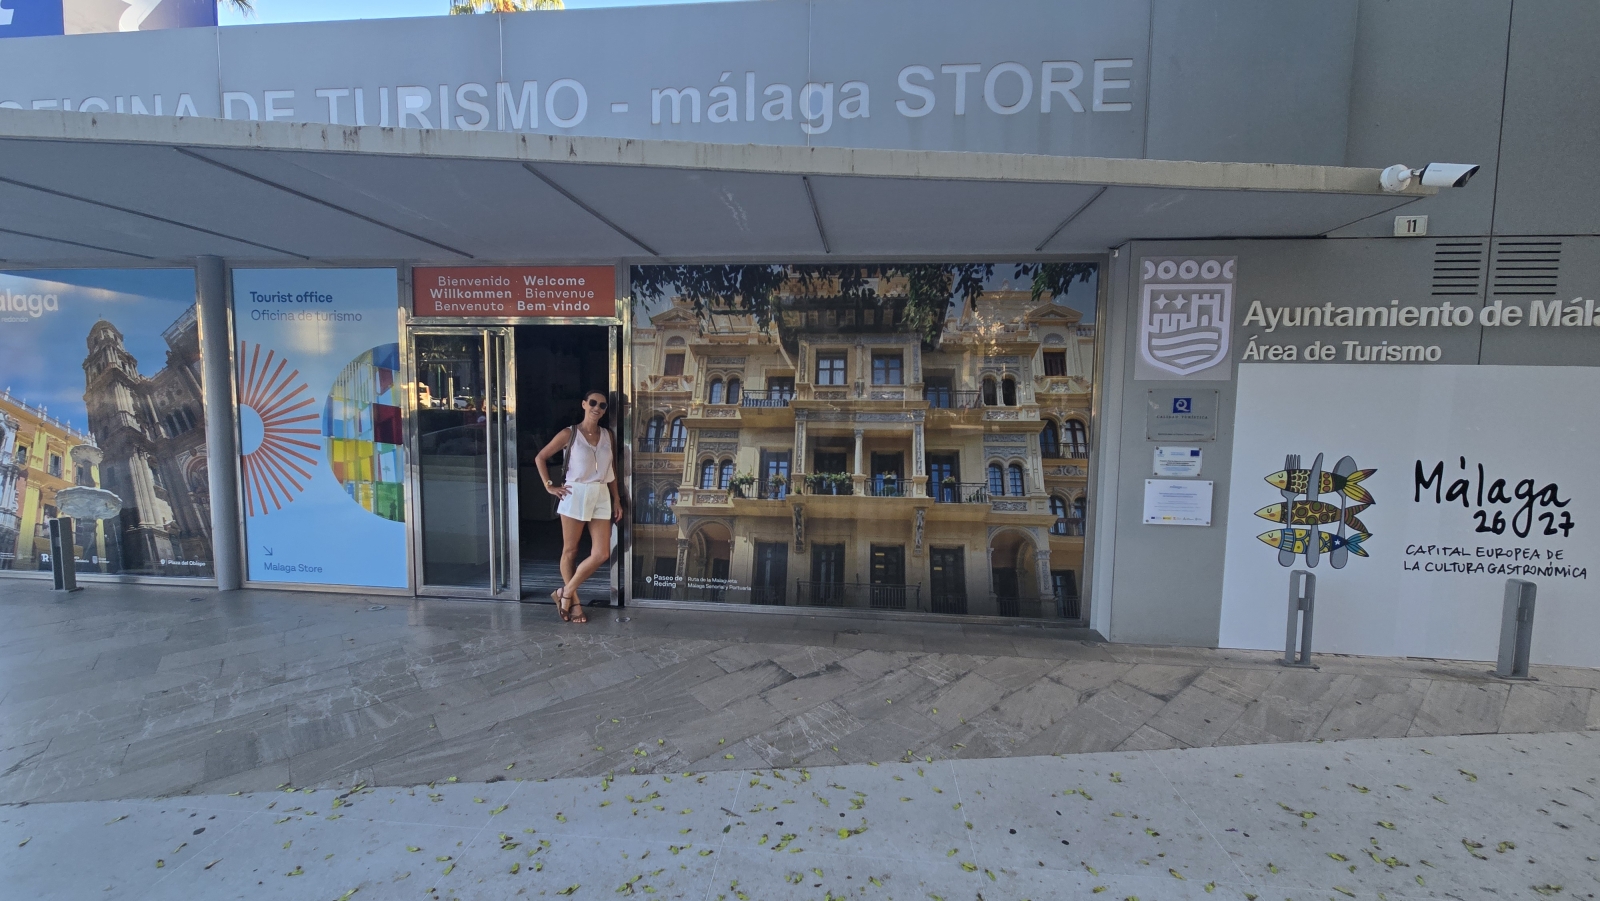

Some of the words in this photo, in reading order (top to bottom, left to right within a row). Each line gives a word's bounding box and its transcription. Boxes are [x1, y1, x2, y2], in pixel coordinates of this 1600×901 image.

[222, 90, 295, 121] DE
[315, 78, 588, 131] TURISMO
[651, 71, 870, 134] málaga
[896, 58, 1134, 118] STORE
[1406, 219, 1418, 233] 11
[438, 276, 511, 286] Bienvenido
[523, 275, 586, 286] Welcome
[249, 291, 293, 303] Tourist
[296, 291, 333, 303] office
[430, 288, 512, 299] Willkommen
[525, 288, 595, 299] Bienvenue
[435, 301, 505, 311] Benvenuto
[517, 300, 591, 311] Bem-vindo
[251, 309, 295, 321] Oficina
[297, 310, 313, 321] de
[315, 310, 363, 322] turismo
[1242, 300, 1474, 333] Ayuntamiento
[1479, 300, 1523, 327] de
[1242, 335, 1297, 361] Área
[1304, 341, 1336, 361] de
[1342, 341, 1442, 362] Turismo
[1414, 455, 1571, 538] Málaga
[1473, 510, 1507, 535] 26
[1538, 511, 1575, 538] 27
[1405, 544, 1471, 557] CAPITAL
[1476, 547, 1540, 560] EUROPEA
[1546, 549, 1564, 560] DE
[264, 562, 296, 573] Malaga
[298, 563, 323, 573] Store
[1403, 560, 1420, 572] LA
[1424, 562, 1484, 574] CULTURA
[1487, 562, 1587, 579] GASTRONÓMICA
